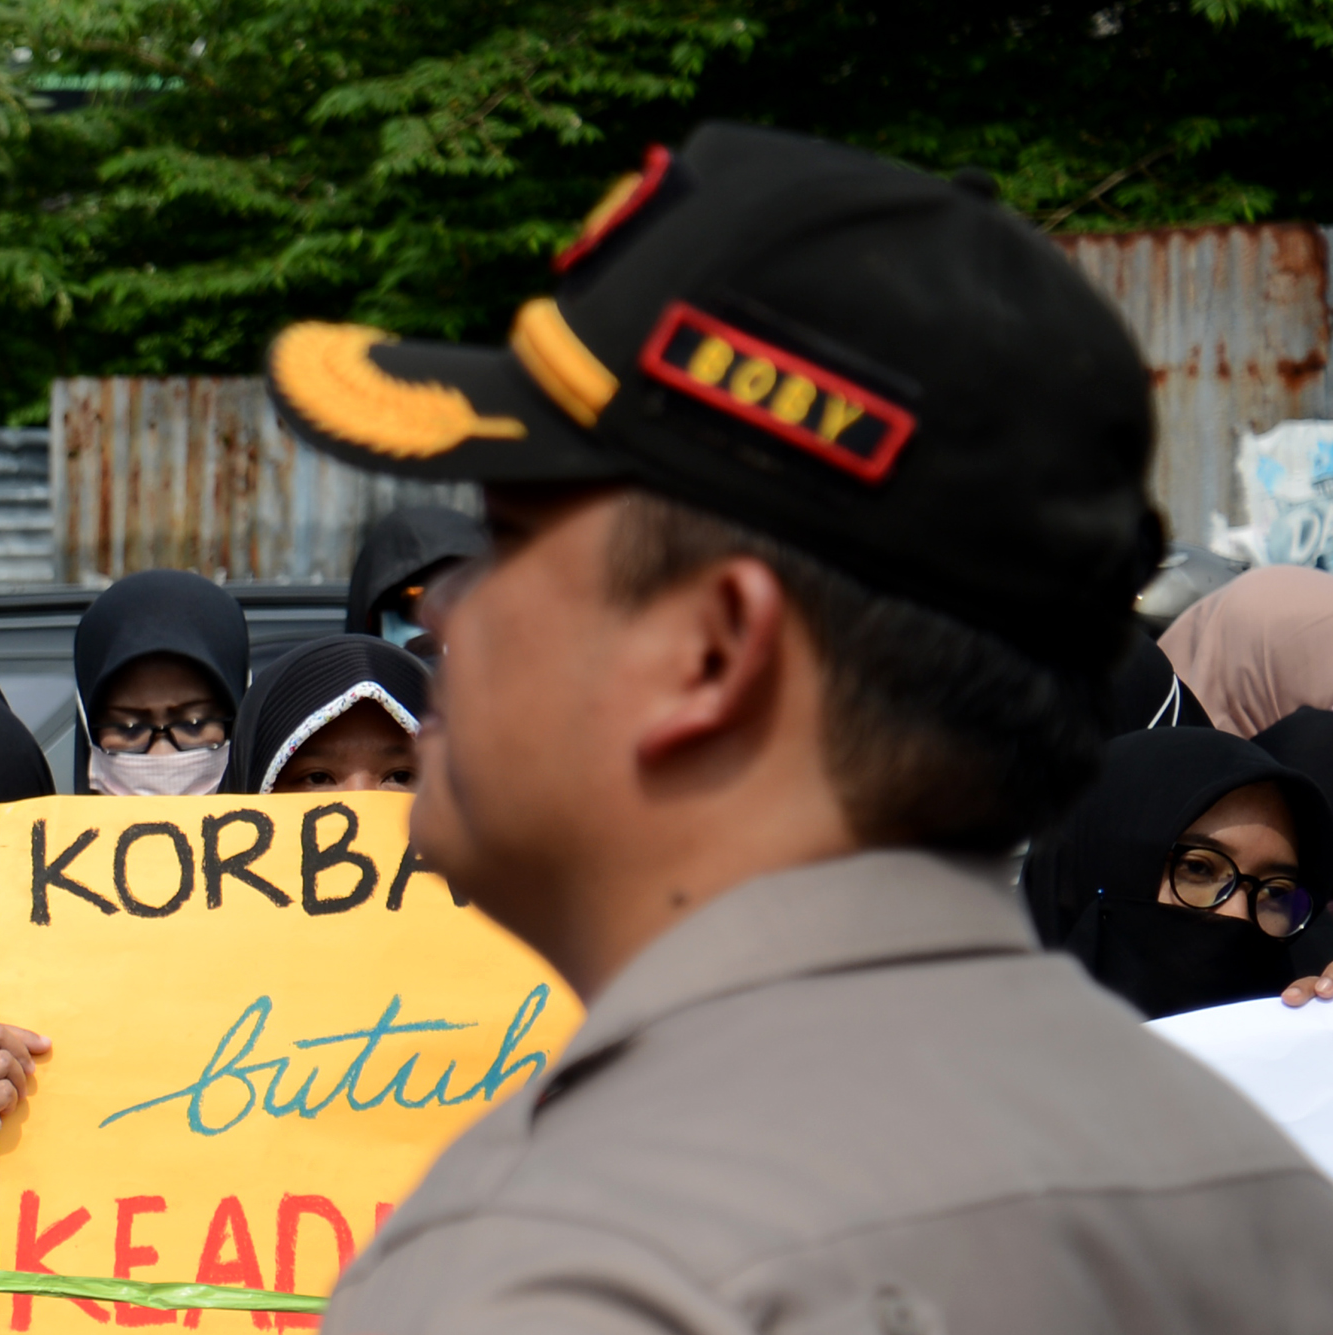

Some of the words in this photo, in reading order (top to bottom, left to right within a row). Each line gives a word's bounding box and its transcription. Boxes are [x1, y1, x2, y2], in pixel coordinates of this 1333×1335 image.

[689, 336, 865, 444] BOBY
[99, 982, 551, 1136] butuh
[10, 1190, 395, 1334] KEAD
